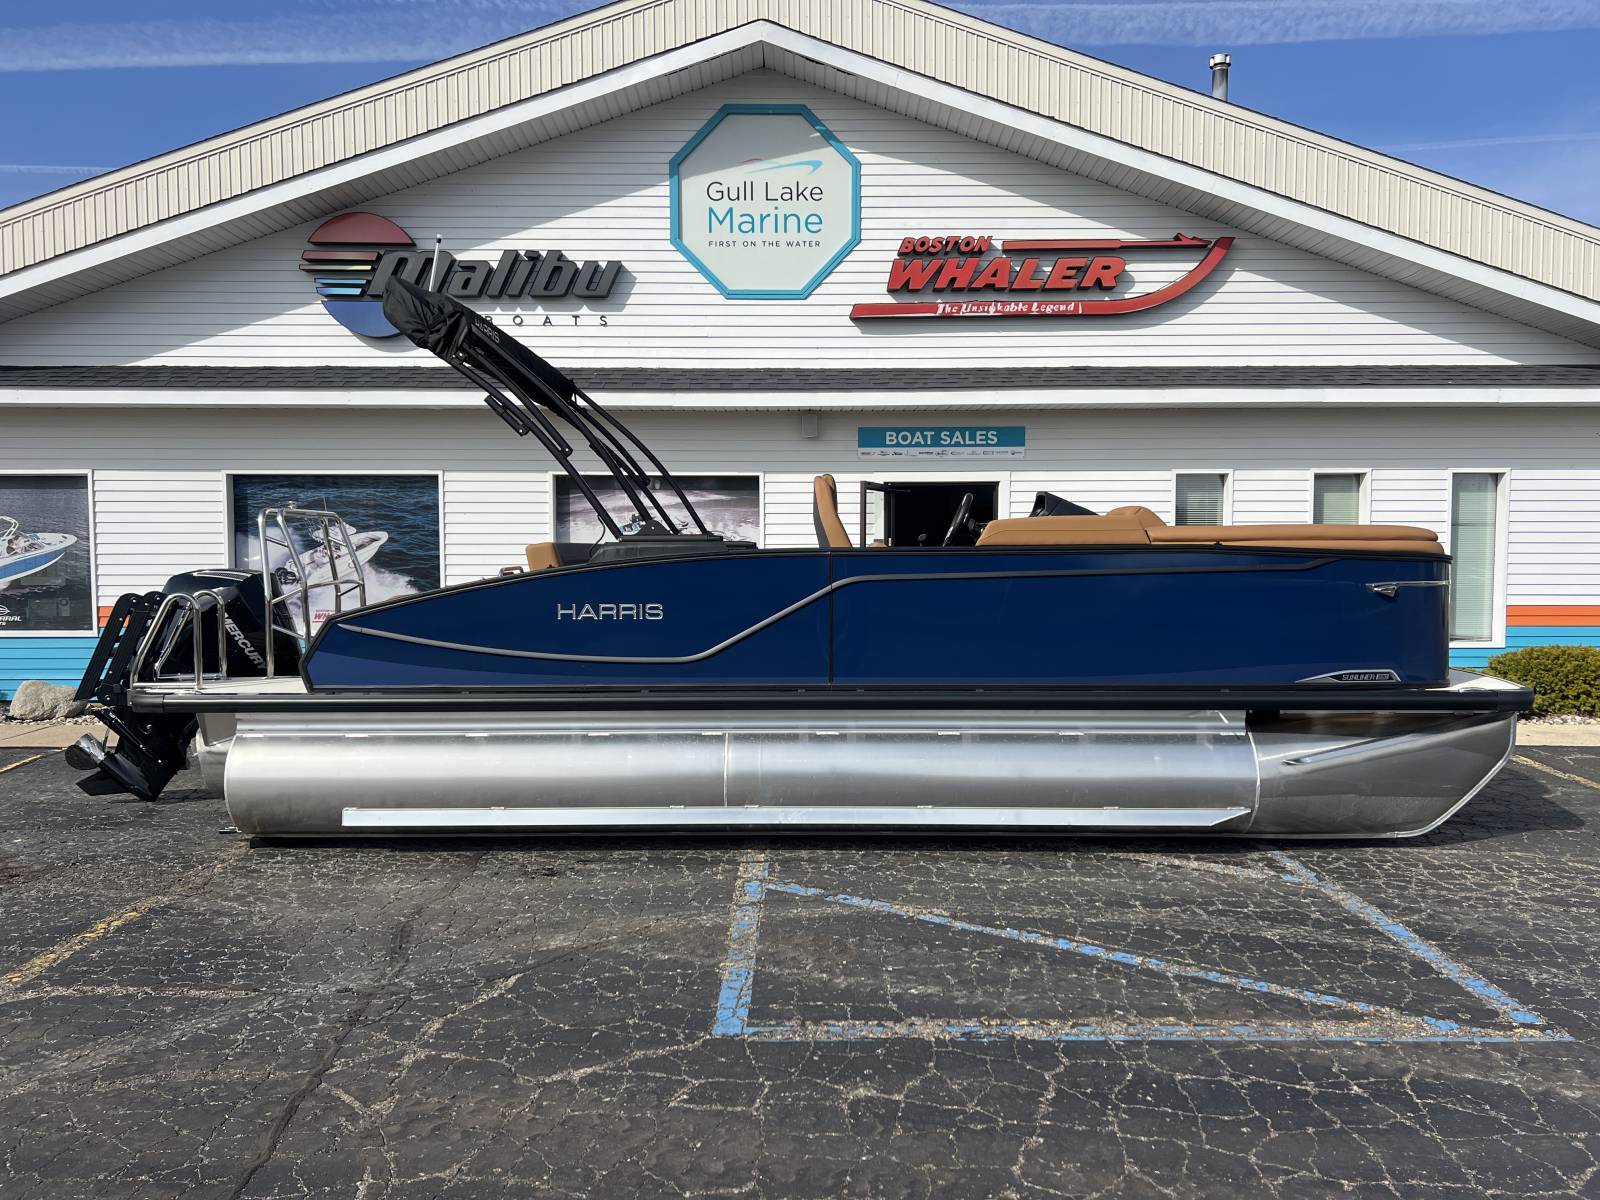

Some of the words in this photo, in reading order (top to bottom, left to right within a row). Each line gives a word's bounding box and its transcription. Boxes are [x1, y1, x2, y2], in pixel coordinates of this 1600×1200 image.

[706, 181, 754, 202] Gull
[765, 181, 823, 202] Lake
[708, 206, 823, 234] Marine
[708, 240, 737, 248] FIRST
[742, 240, 757, 248] ON
[762, 240, 781, 248] THE
[786, 240, 821, 248] WATER
[898, 236, 992, 255] BOSTON
[367, 249, 622, 299] Malibu
[887, 256, 1126, 292] WHALER
[1031, 302, 1074, 314] Legend
[885, 431, 935, 445] BOAT
[940, 431, 998, 445] SALES
[556, 603, 664, 620] HARRIS
